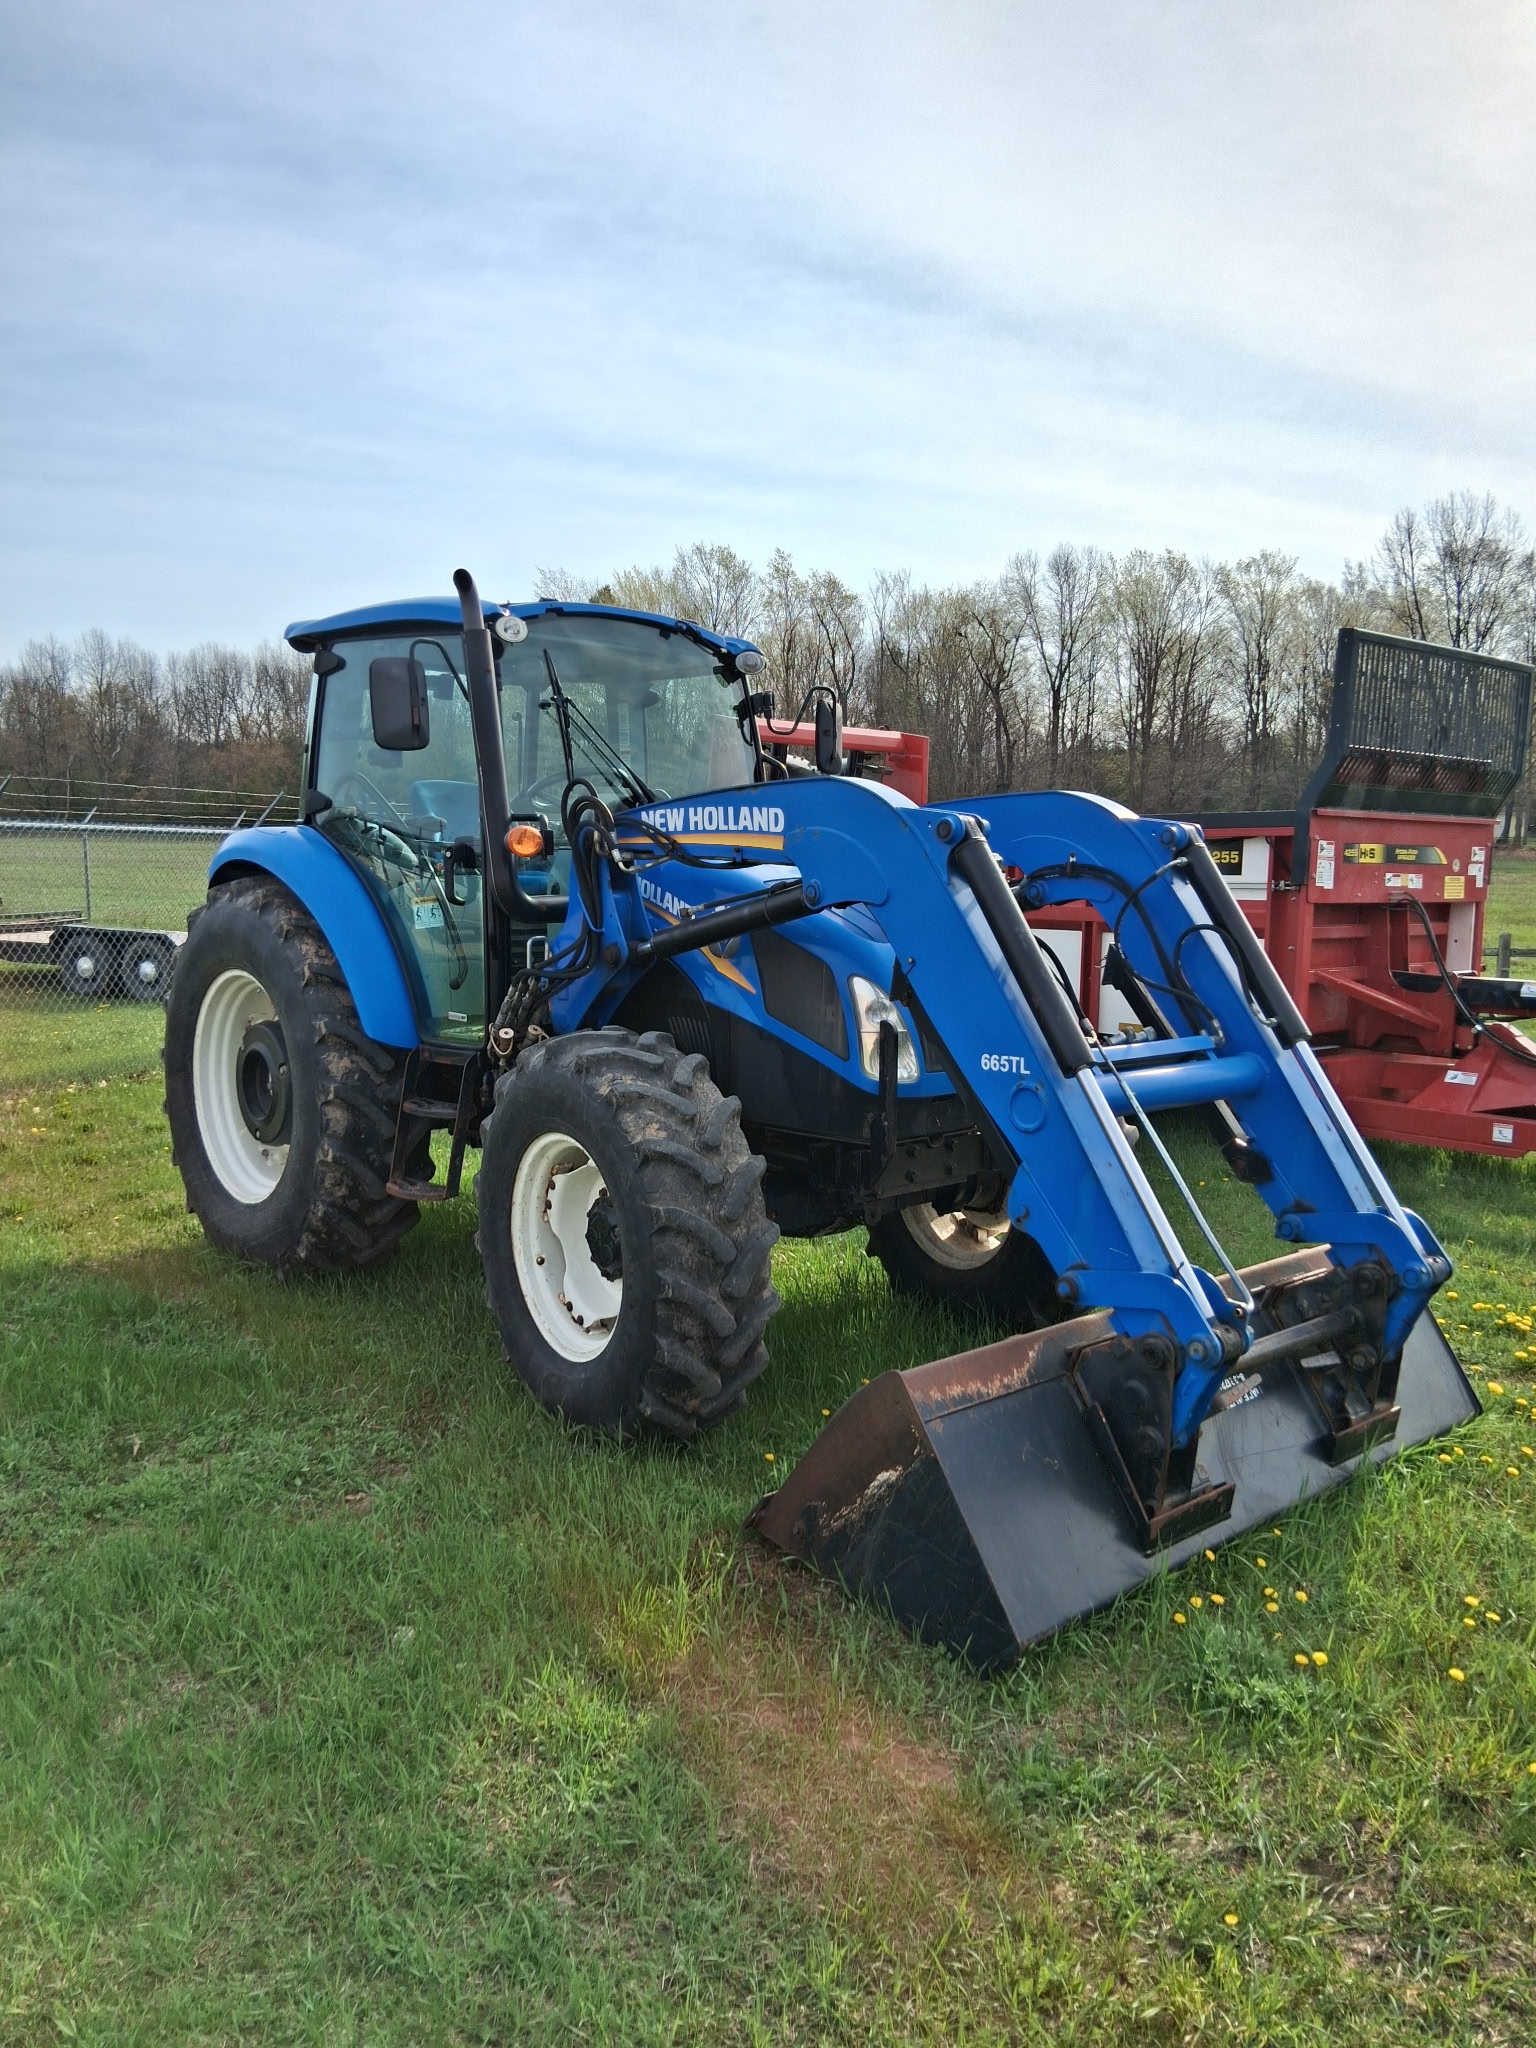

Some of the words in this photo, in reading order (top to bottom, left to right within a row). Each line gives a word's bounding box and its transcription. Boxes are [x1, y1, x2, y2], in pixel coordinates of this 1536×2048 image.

[641, 807, 685, 833] NEW
[688, 806, 785, 833] HOLLAND
[980, 1053, 1031, 1075] 665TL
